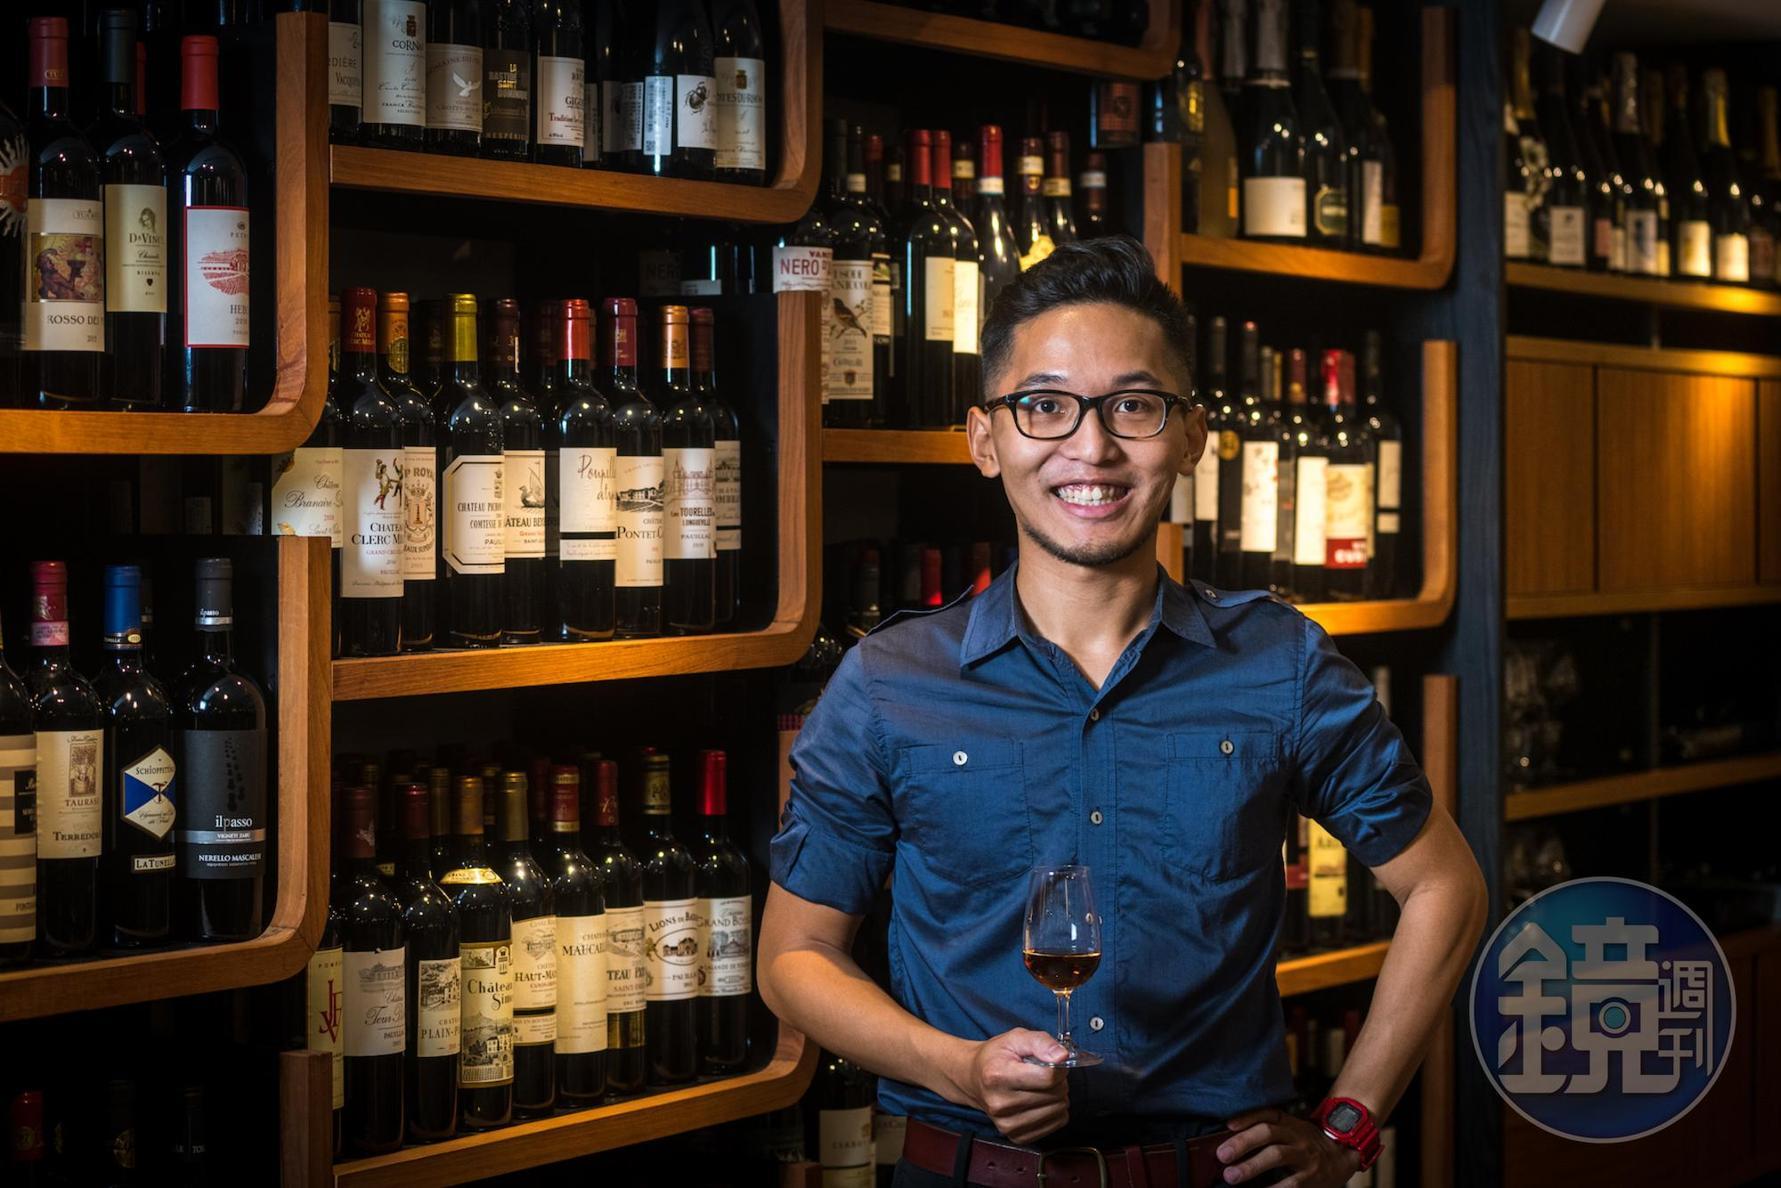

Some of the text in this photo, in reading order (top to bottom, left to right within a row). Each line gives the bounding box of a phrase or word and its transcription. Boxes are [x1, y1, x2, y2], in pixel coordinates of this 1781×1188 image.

[780, 258, 820, 275] NERO
[351, 533, 391, 546] CLERC
[198, 854, 231, 862] NERELLO
[648, 915, 677, 932] LIONS
